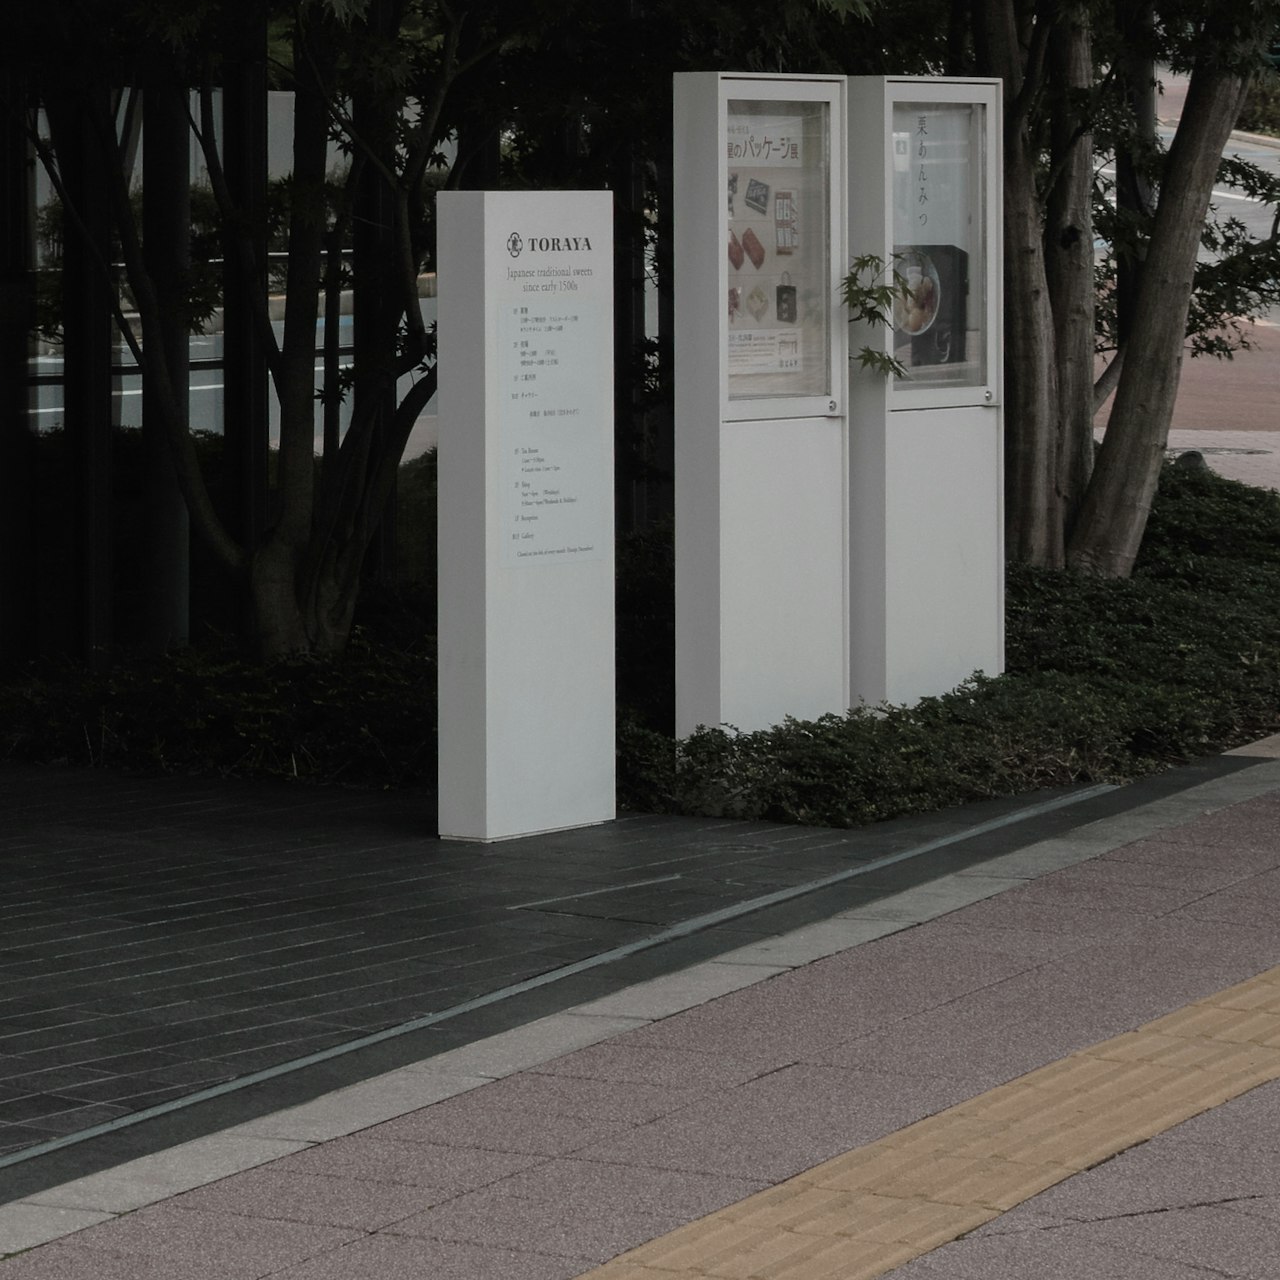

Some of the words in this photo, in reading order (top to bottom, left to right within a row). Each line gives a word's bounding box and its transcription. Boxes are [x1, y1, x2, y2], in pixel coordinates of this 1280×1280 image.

[528, 237, 593, 252] TORAYA
[506, 266, 536, 281] Japanese
[537, 265, 572, 278] traditional
[573, 267, 593, 277] sweets
[522, 281, 540, 292] since
[541, 280, 557, 294] early
[559, 280, 578, 292] 1500s
